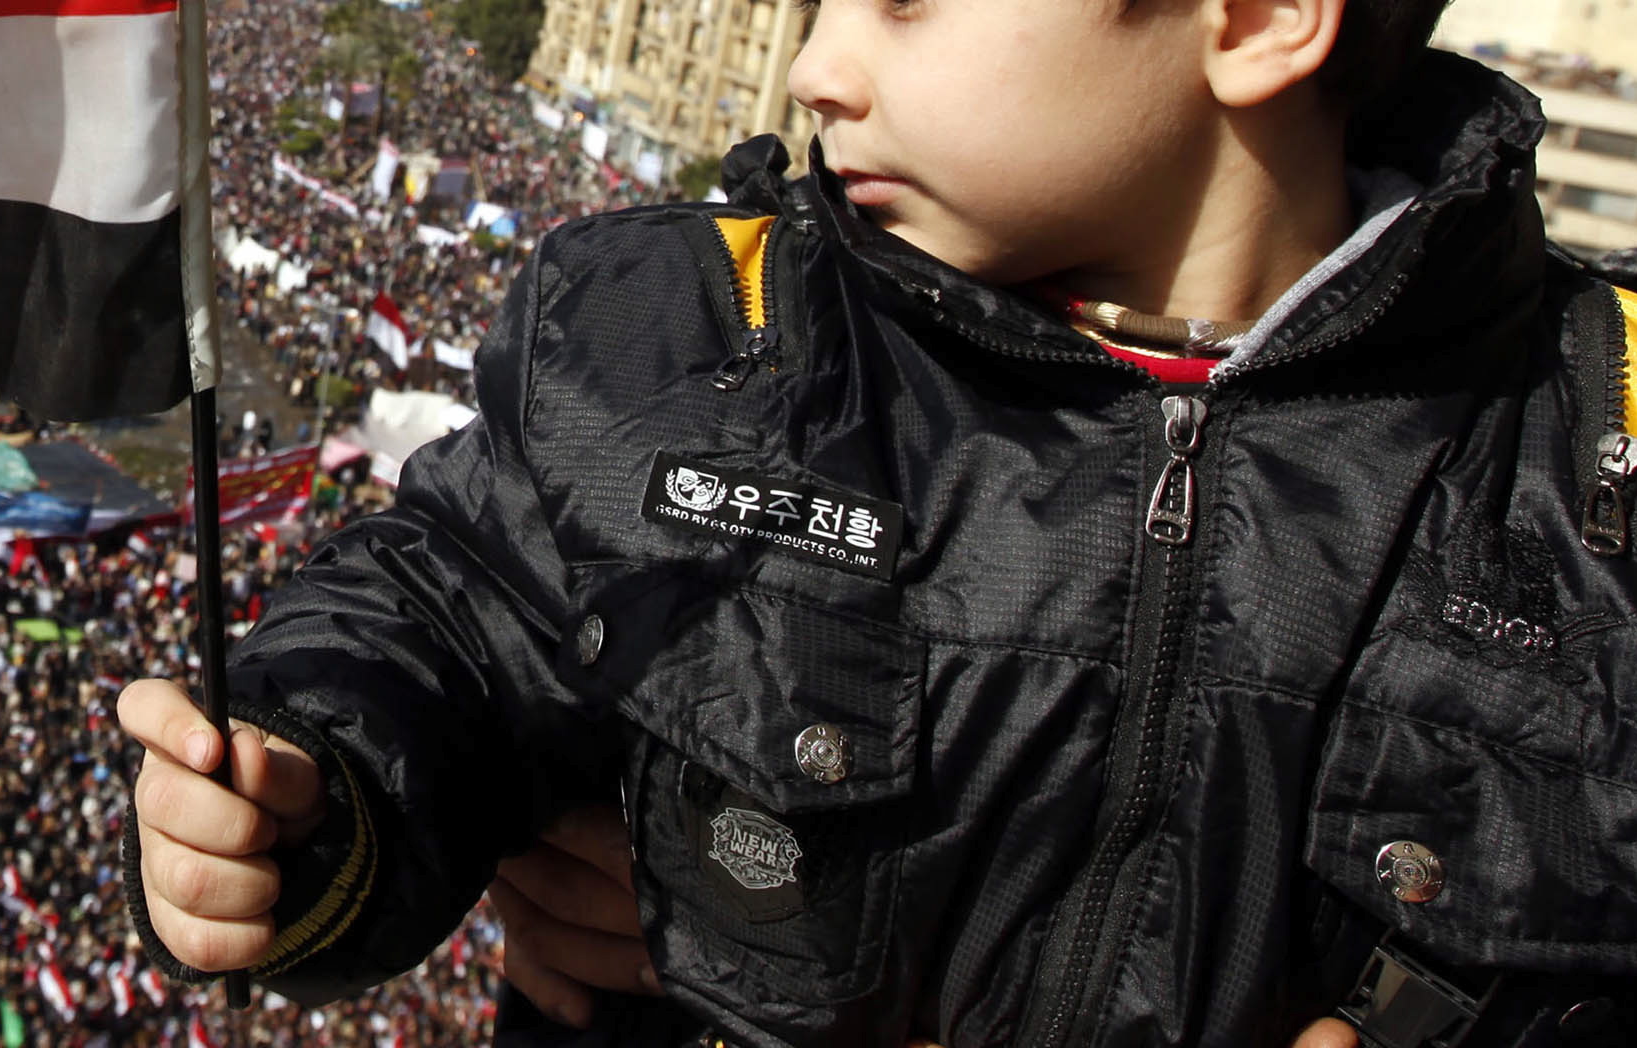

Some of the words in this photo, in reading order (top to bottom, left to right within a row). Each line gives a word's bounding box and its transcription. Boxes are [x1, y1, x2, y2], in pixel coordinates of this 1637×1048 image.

[757, 529, 827, 555] PRODUCTS
[730, 839, 777, 867] WEAR
[732, 827, 778, 855] NEW
